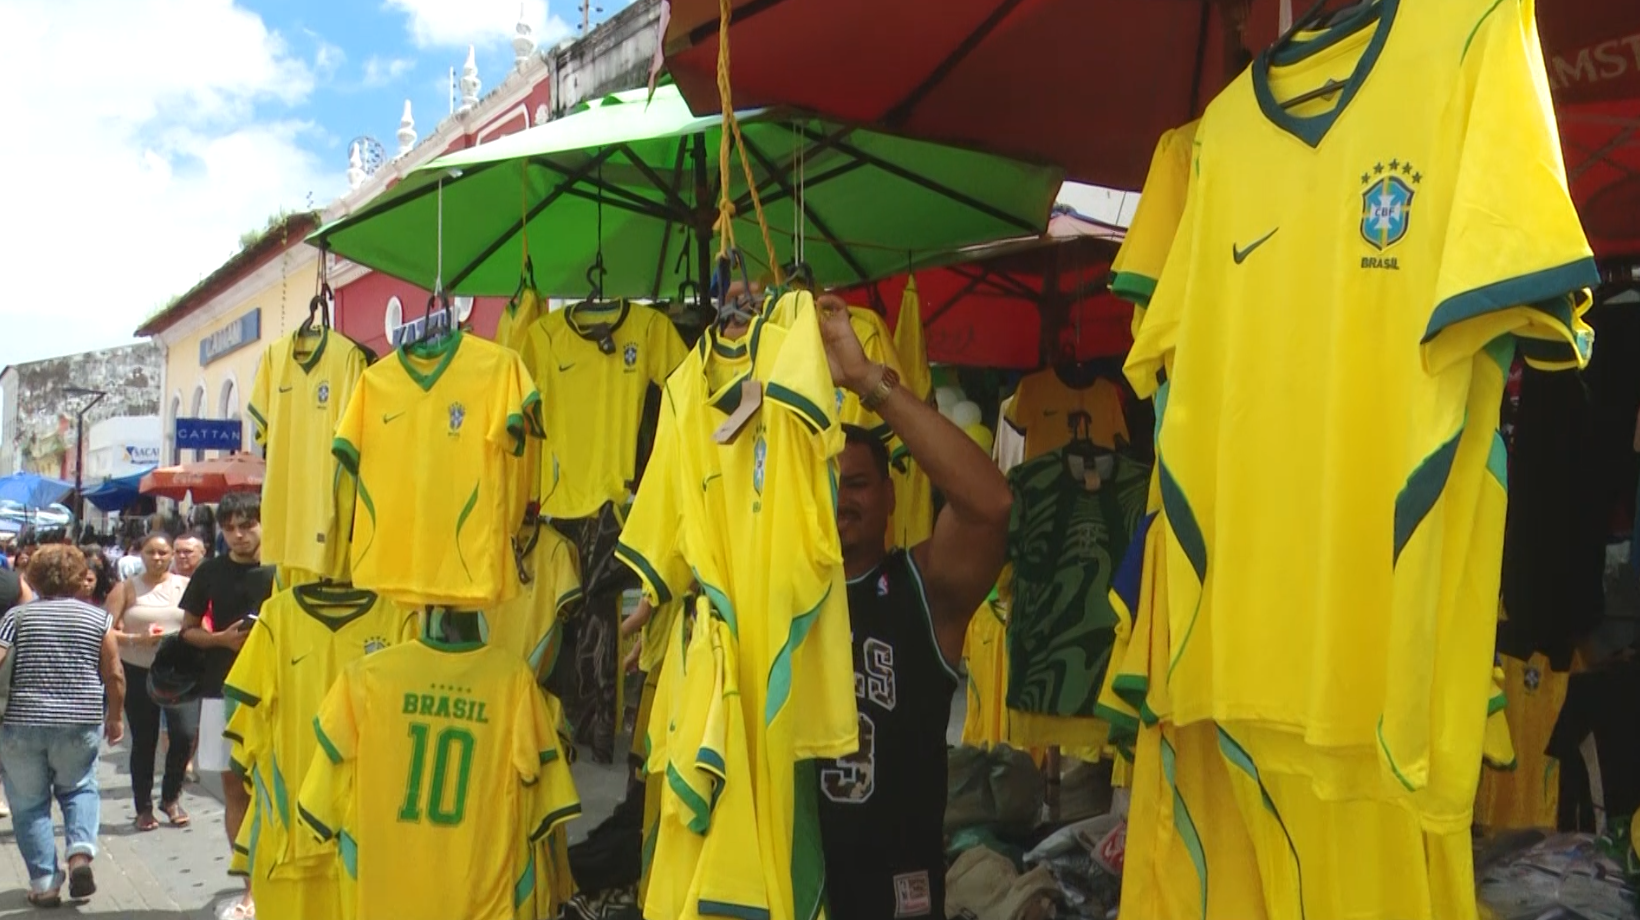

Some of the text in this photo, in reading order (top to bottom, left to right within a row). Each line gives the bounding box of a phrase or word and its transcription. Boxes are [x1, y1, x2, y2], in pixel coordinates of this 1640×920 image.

[1374, 206, 1395, 217] CBF
[1361, 257, 1400, 270] BRASIL
[177, 428, 241, 440] CATTAN
[403, 693, 489, 723] BRASIL
[397, 722, 477, 828] 10
